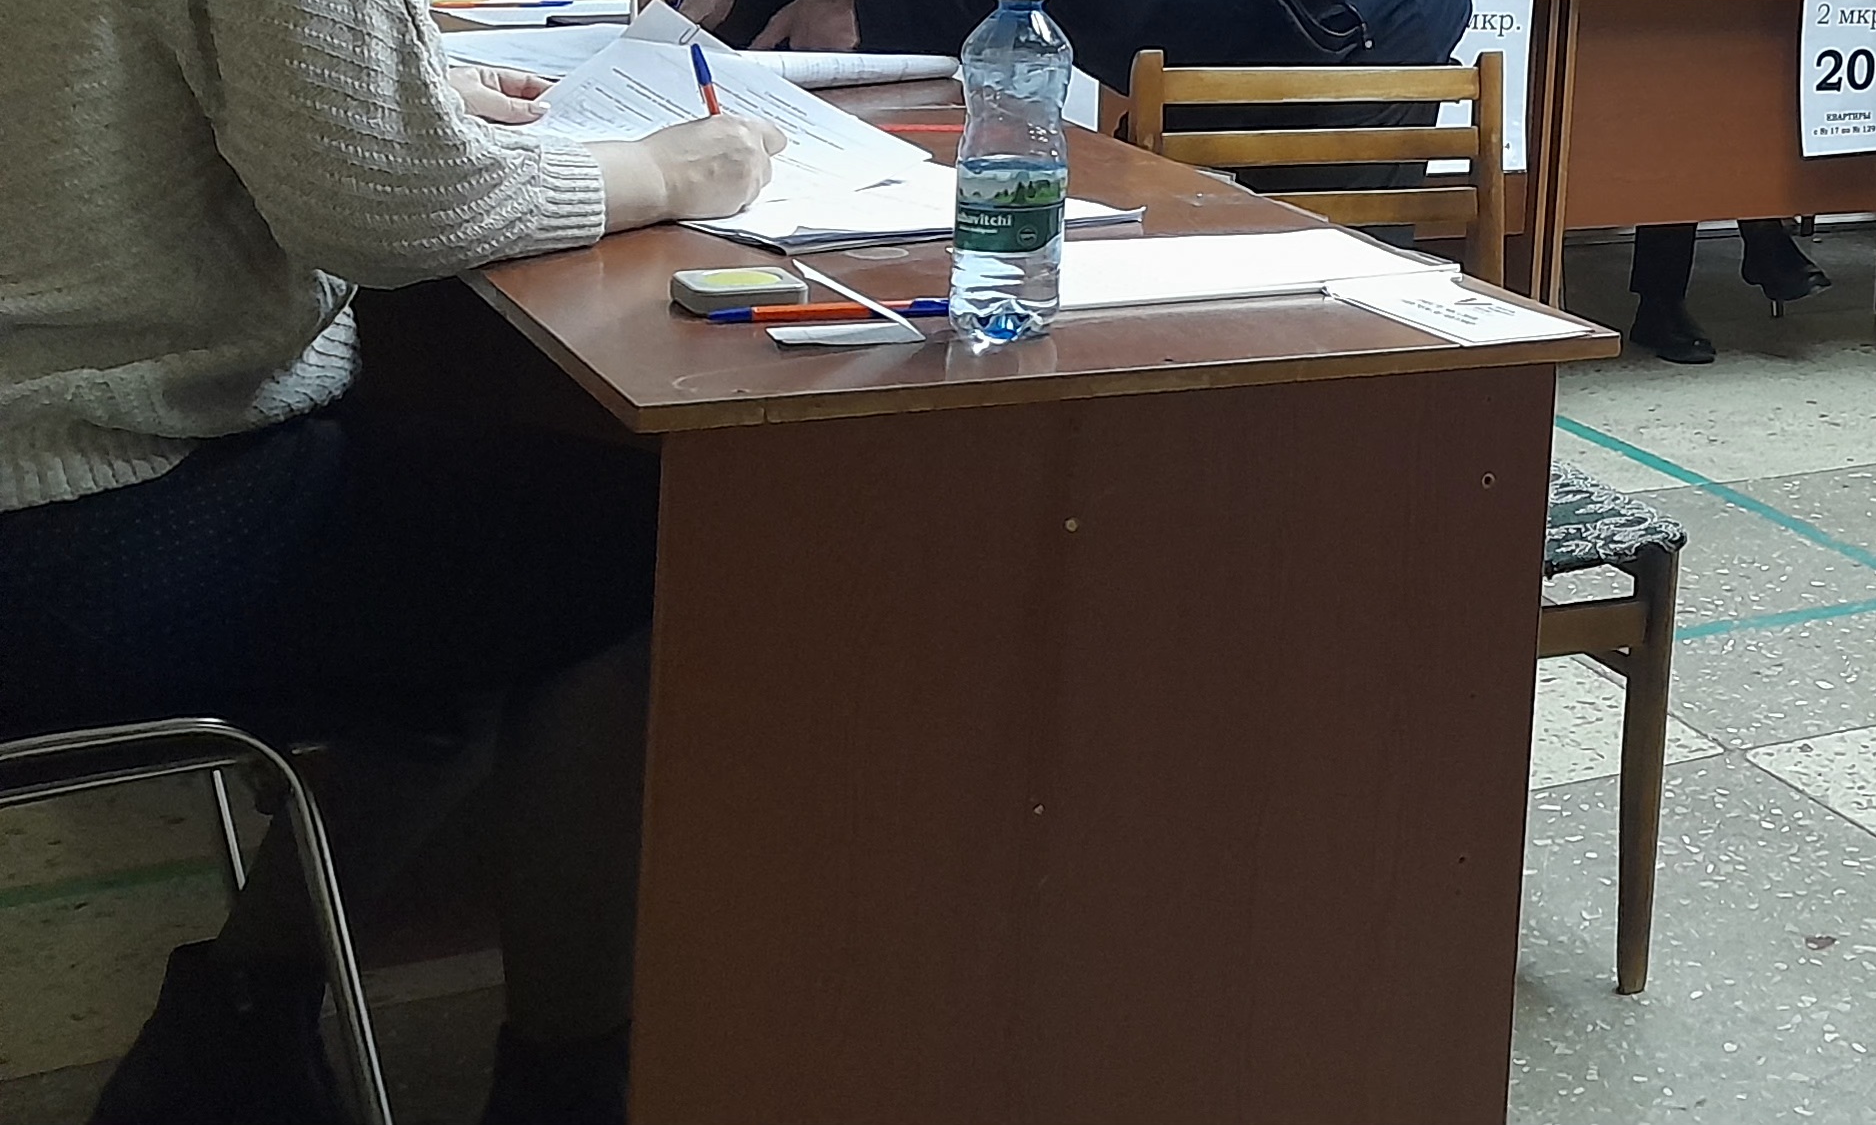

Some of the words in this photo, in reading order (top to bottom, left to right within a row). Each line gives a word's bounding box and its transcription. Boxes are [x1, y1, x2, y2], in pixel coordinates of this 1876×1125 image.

[1817, 4, 1830, 24] 2
[1815, 48, 1875, 92] 20
[1826, 112, 1871, 121] КВАРТИРЫ
